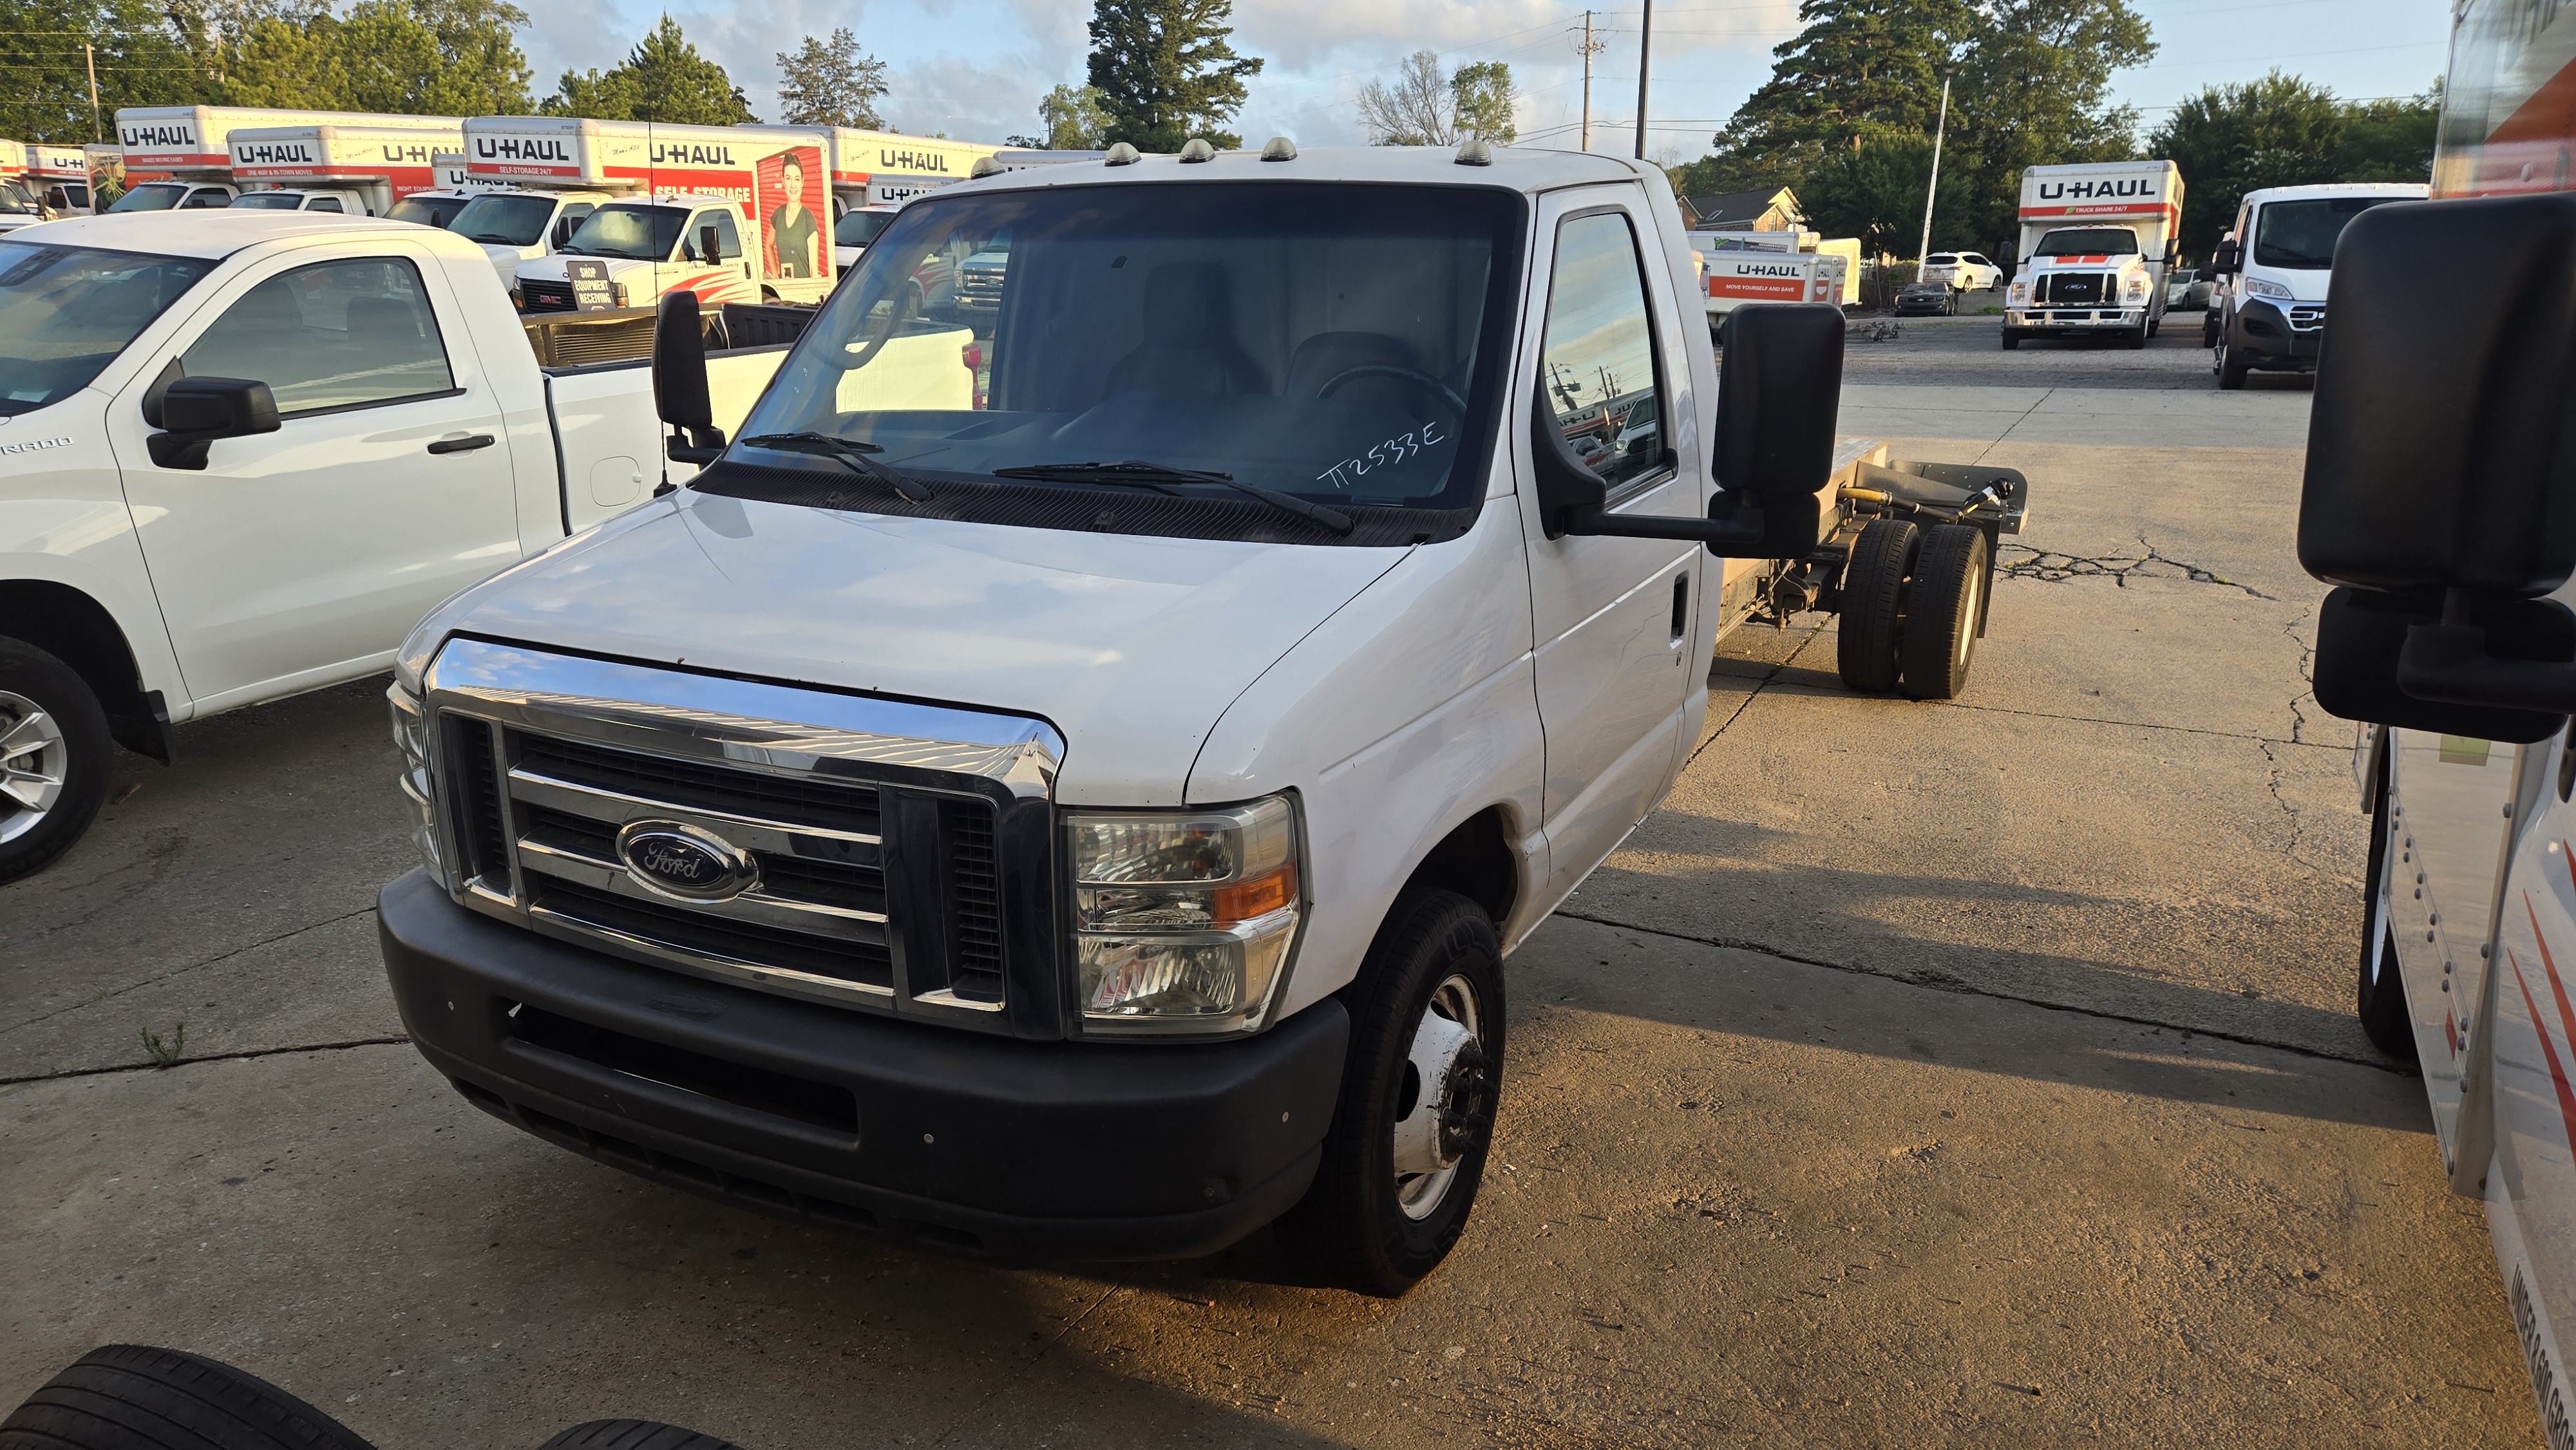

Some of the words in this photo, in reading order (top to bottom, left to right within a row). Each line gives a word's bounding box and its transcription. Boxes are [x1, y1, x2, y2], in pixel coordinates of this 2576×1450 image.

[122, 126, 195, 146] U-HAUL
[238, 145, 313, 163] U-HAUL
[477, 138, 569, 161] U-HAUL
[650, 144, 735, 165] U-HAUL
[499, 166, 539, 174] SELF-STORAGE
[881, 149, 948, 172] U-HAUL
[2040, 179, 2155, 200] U-HAUL
[580, 267, 596, 278] SHOP
[1737, 265, 1799, 277] U-HAUL
[574, 280, 608, 291] EQUIPMENT
[540, 295, 561, 304] GMC
[579, 293, 611, 304] RECEIVING
[644, 842, 699, 879] Ford
[2512, 1262, 2536, 1362] UNDER
